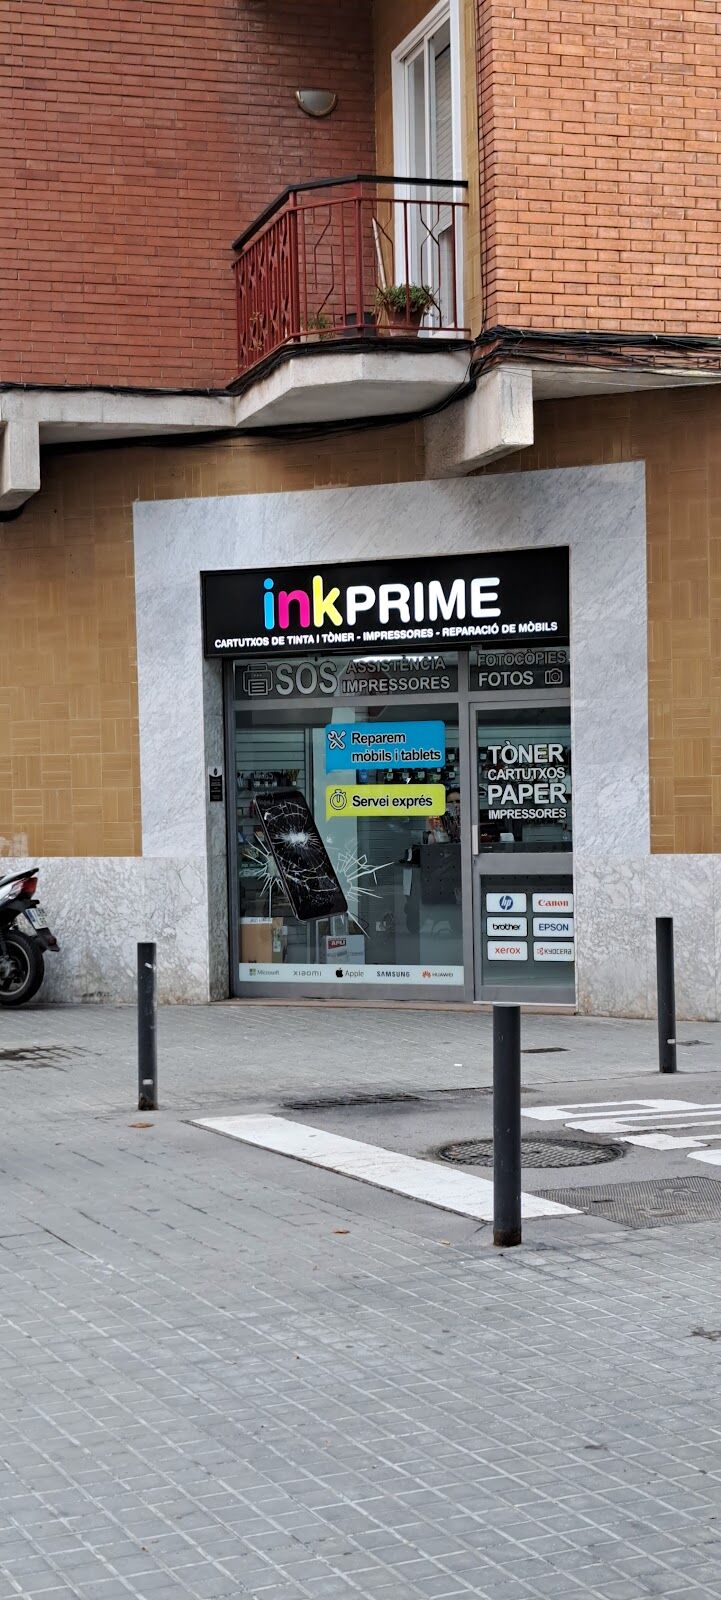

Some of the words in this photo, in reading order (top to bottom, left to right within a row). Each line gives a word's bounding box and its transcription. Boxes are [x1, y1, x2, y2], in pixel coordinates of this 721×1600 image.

[214, 637, 270, 648] CARTUTXOS
[271, 636, 285, 646] DE
[287, 634, 315, 645] TINTA
[316, 633, 320, 644] I
[322, 631, 355, 643] TÒNER
[363, 628, 434, 641] IMPRESSORES
[442, 623, 499, 637] REPARACIÓ
[501, 623, 516, 634] DE
[518, 621, 558, 633] MÒBILS
[477, 649, 567, 667] FOTOCÒPIES
[346, 656, 446, 675] ASSISTÈNCIA
[275, 660, 338, 696] SOS
[342, 676, 451, 693] IMPRESSORES
[478, 670, 534, 687] FOTOS
[351, 732, 406, 747] Reparem
[352, 749, 392, 762] mòbils
[394, 749, 398, 761] i
[400, 748, 442, 761] tablets
[487, 740, 565, 765] TÒNER
[487, 767, 566, 781] CARTUTXOS
[352, 795, 389, 807] Servei
[391, 794, 433, 809] exprés
[487, 783, 568, 806] PAPER
[488, 808, 567, 820] IMPRESSORES
[500, 896, 513, 910] hp
[538, 899, 569, 907] Canon
[492, 923, 521, 931] brother
[538, 923, 569, 931] EPSON
[495, 947, 521, 955] xerox
[345, 969, 365, 978] Apple
[376, 970, 411, 978] SAMSUNG
